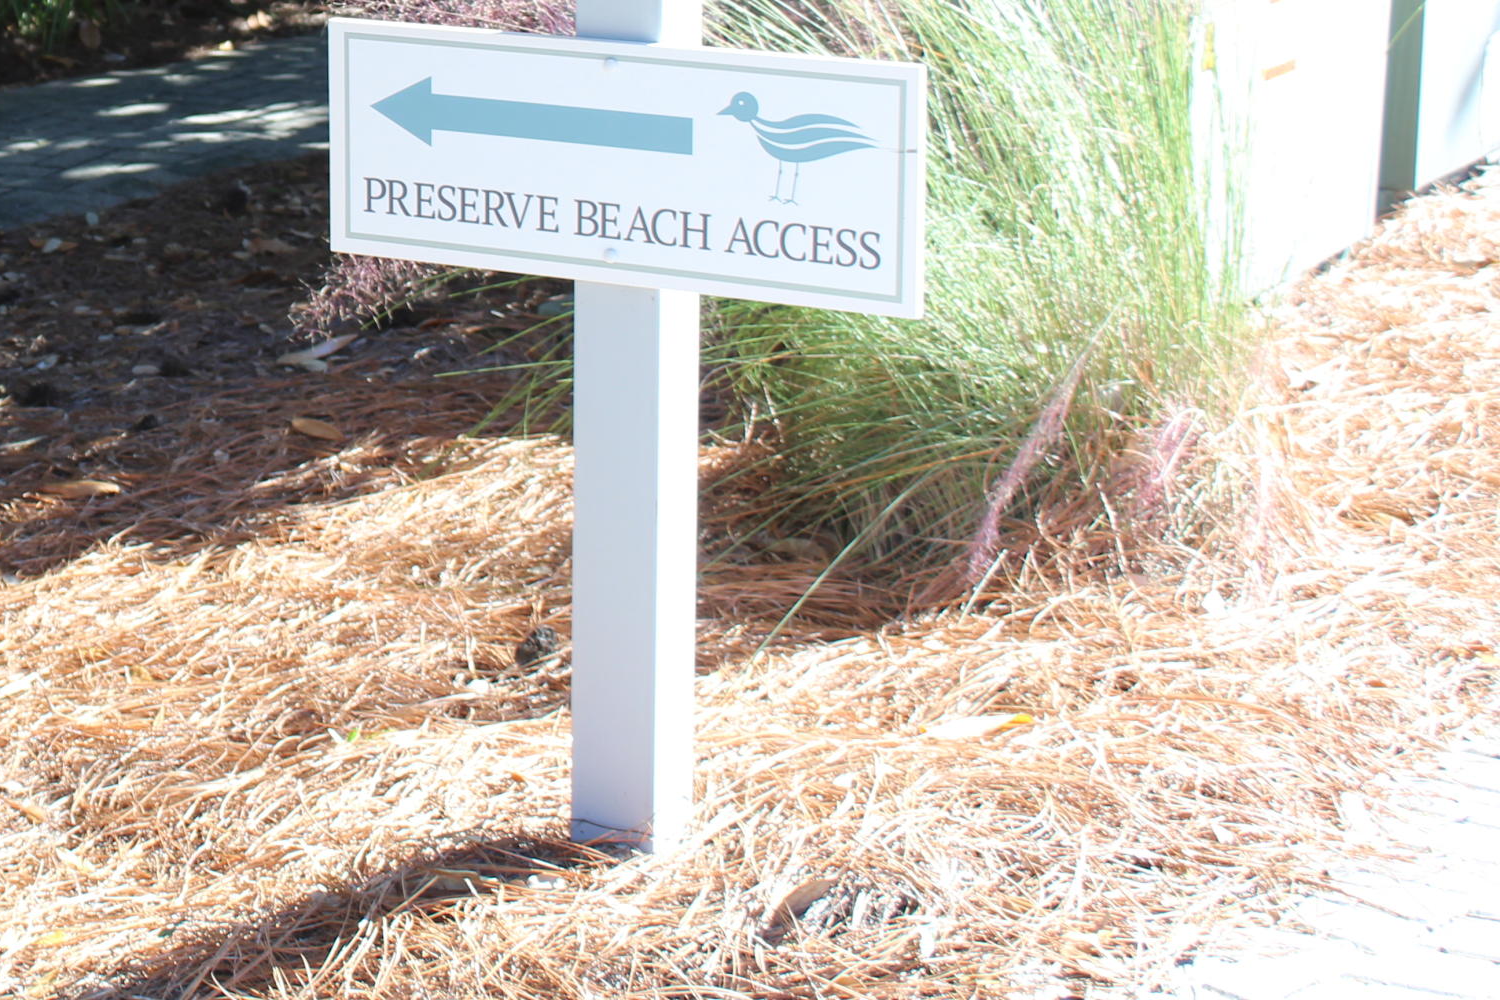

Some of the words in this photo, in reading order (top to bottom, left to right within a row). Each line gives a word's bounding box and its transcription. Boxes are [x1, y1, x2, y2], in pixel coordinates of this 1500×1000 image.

[363, 176, 560, 234] PRESERVE
[573, 199, 712, 251] BEACH
[724, 217, 882, 270] ACCESS
